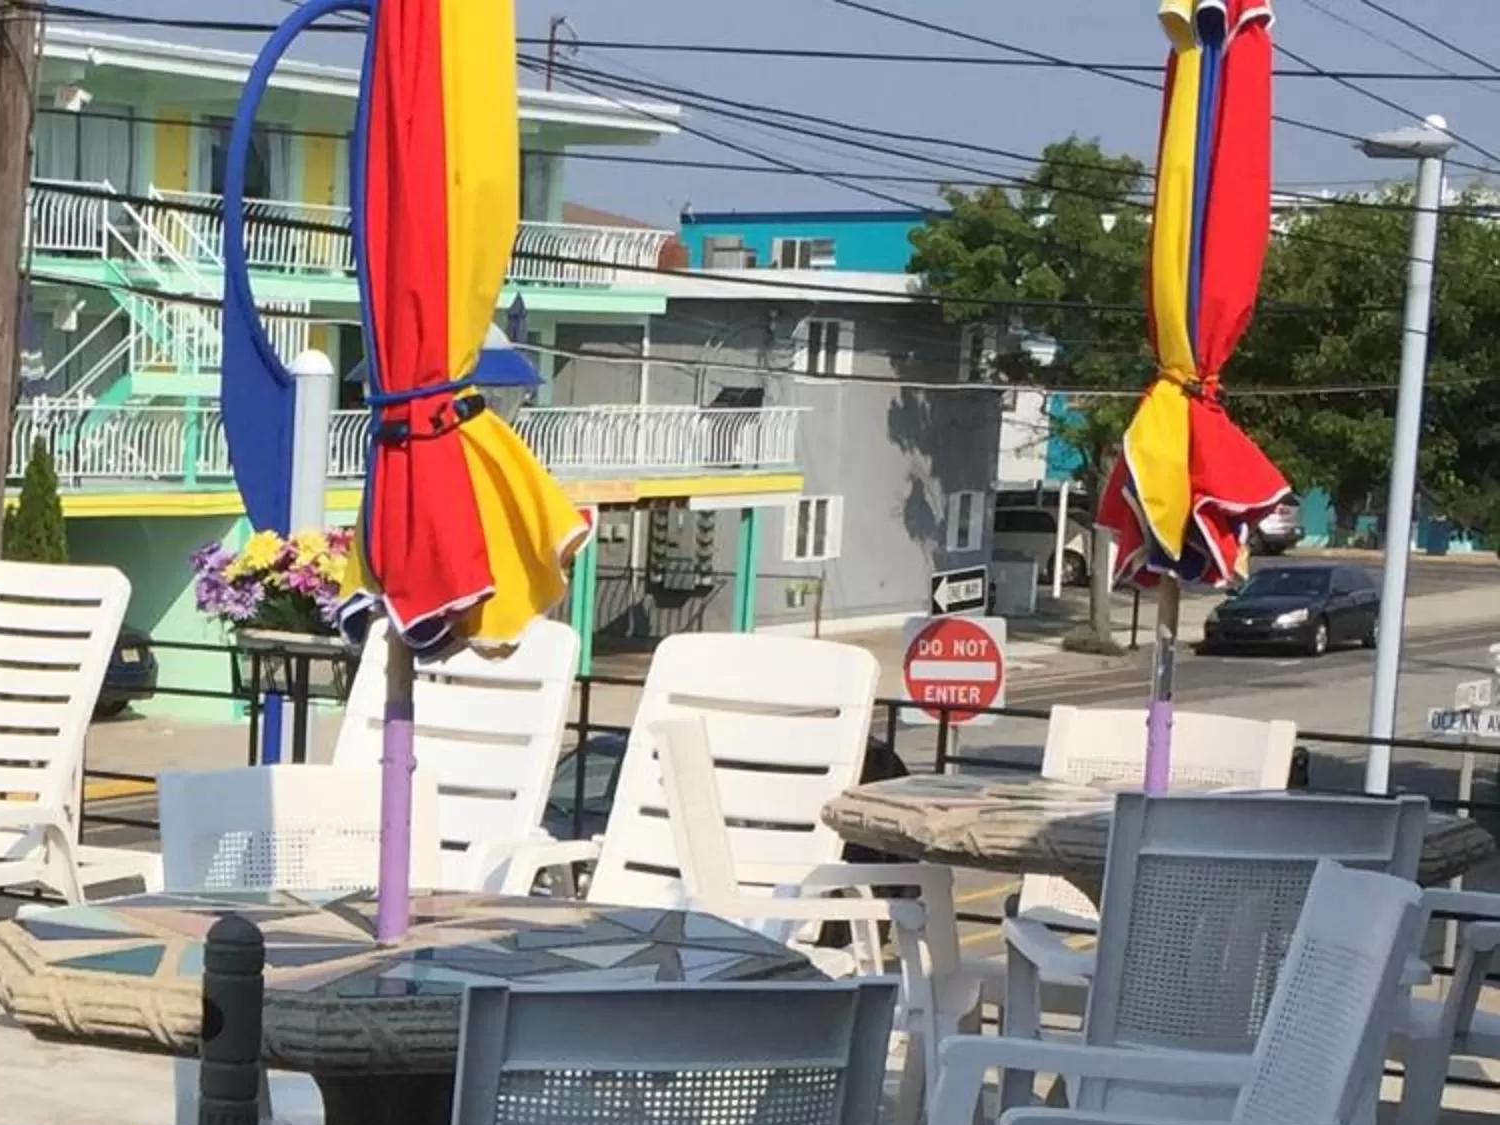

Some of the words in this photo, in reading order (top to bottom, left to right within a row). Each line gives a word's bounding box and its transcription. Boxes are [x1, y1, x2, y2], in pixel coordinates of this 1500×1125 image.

[918, 639, 943, 656] DO
[953, 639, 989, 656] NOT
[924, 685, 981, 704] ENTER
